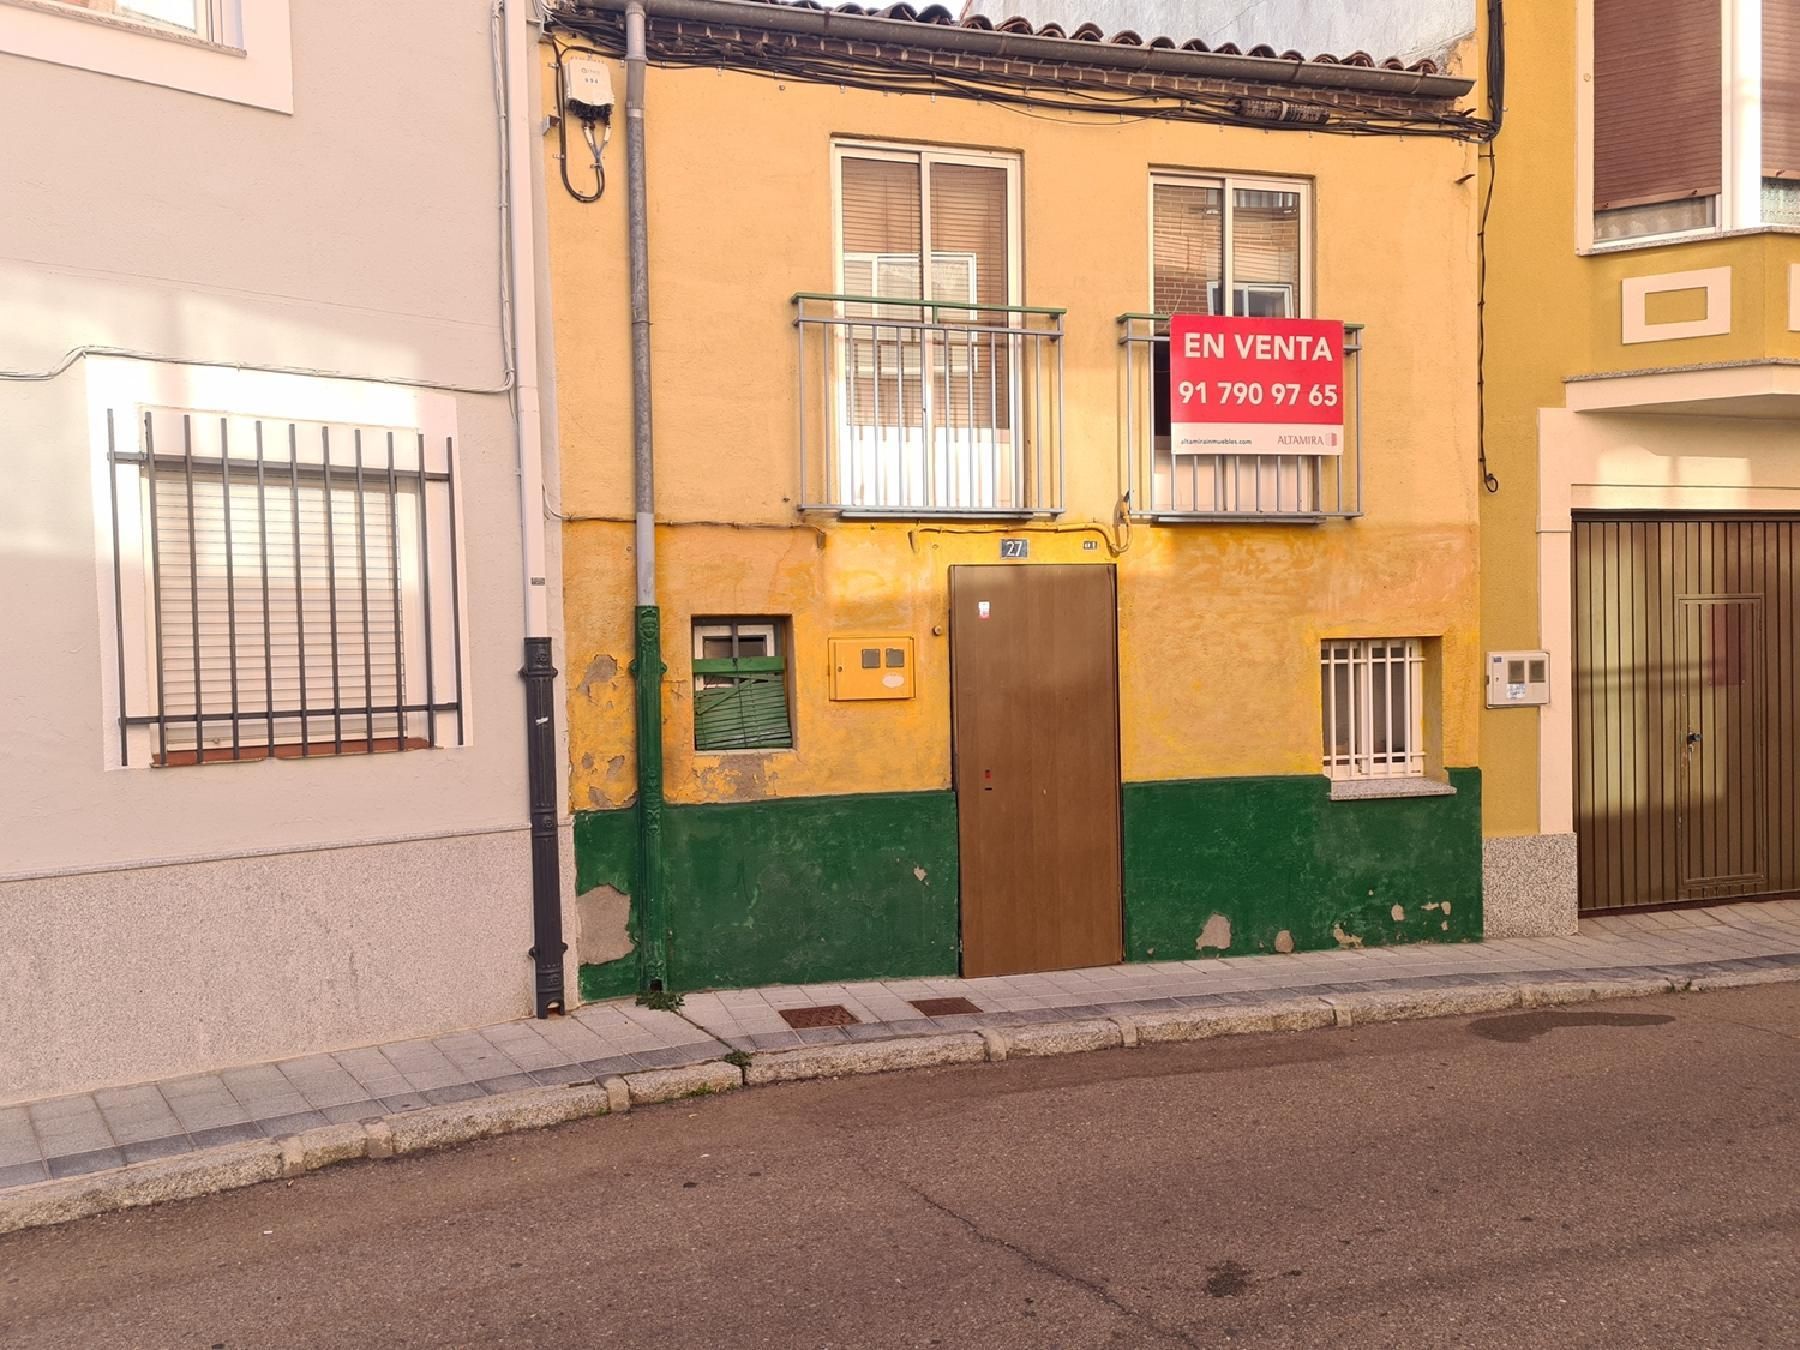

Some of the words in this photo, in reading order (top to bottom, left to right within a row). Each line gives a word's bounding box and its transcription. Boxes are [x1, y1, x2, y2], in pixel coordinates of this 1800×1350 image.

[1184, 333, 1225, 359] EN
[1234, 334, 1333, 361] VENTA
[1179, 382, 1207, 404] 91
[1217, 382, 1263, 405] 790
[1271, 383, 1301, 405] 97
[1308, 384, 1338, 407] 65
[1277, 435, 1324, 446] ALTAMIRA
[1006, 540, 1022, 557] 27
